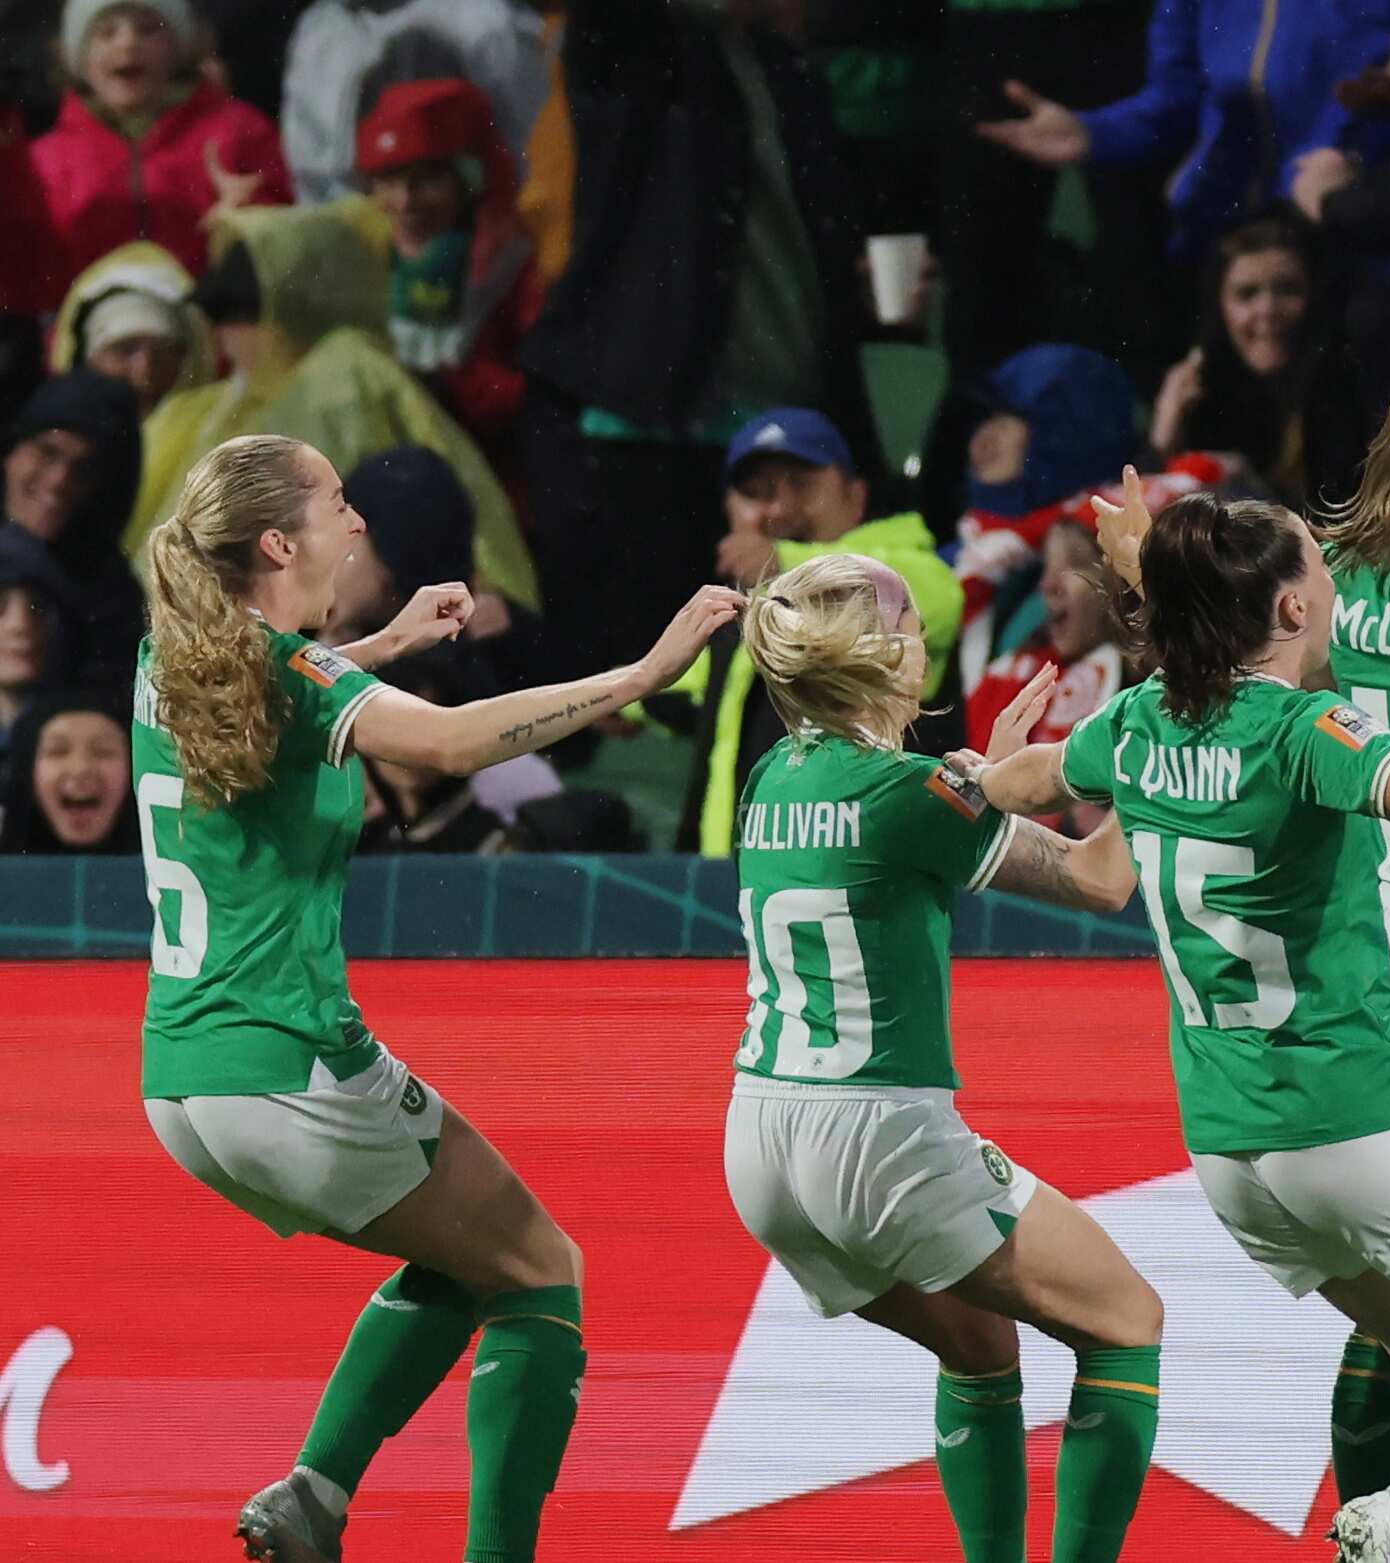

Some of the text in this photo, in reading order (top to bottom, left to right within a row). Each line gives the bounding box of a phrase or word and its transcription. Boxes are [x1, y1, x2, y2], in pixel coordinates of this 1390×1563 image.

[1140, 739, 1241, 800] QUINN
[138, 773, 208, 978] 6
[1132, 831, 1296, 1029] 15
[735, 888, 873, 1079] 10
